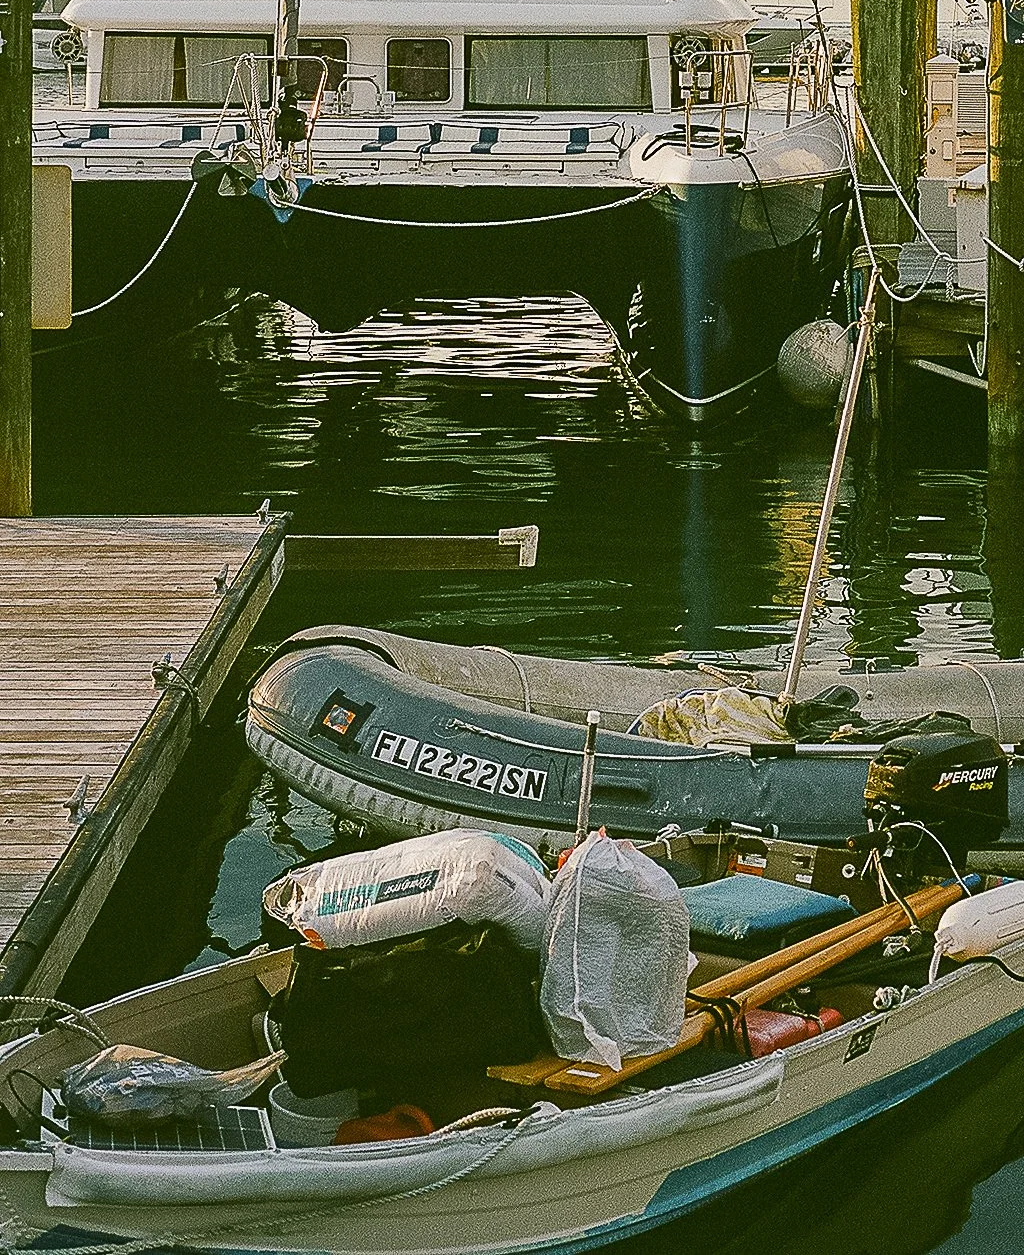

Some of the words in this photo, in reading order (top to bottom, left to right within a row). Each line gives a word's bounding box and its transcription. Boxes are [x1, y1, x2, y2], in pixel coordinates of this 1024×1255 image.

[374, 732, 409, 767] FL
[418, 746, 498, 791] 2222
[502, 766, 545, 799] SN
[939, 765, 998, 785] MERCURY
[969, 781, 993, 791] Racing
